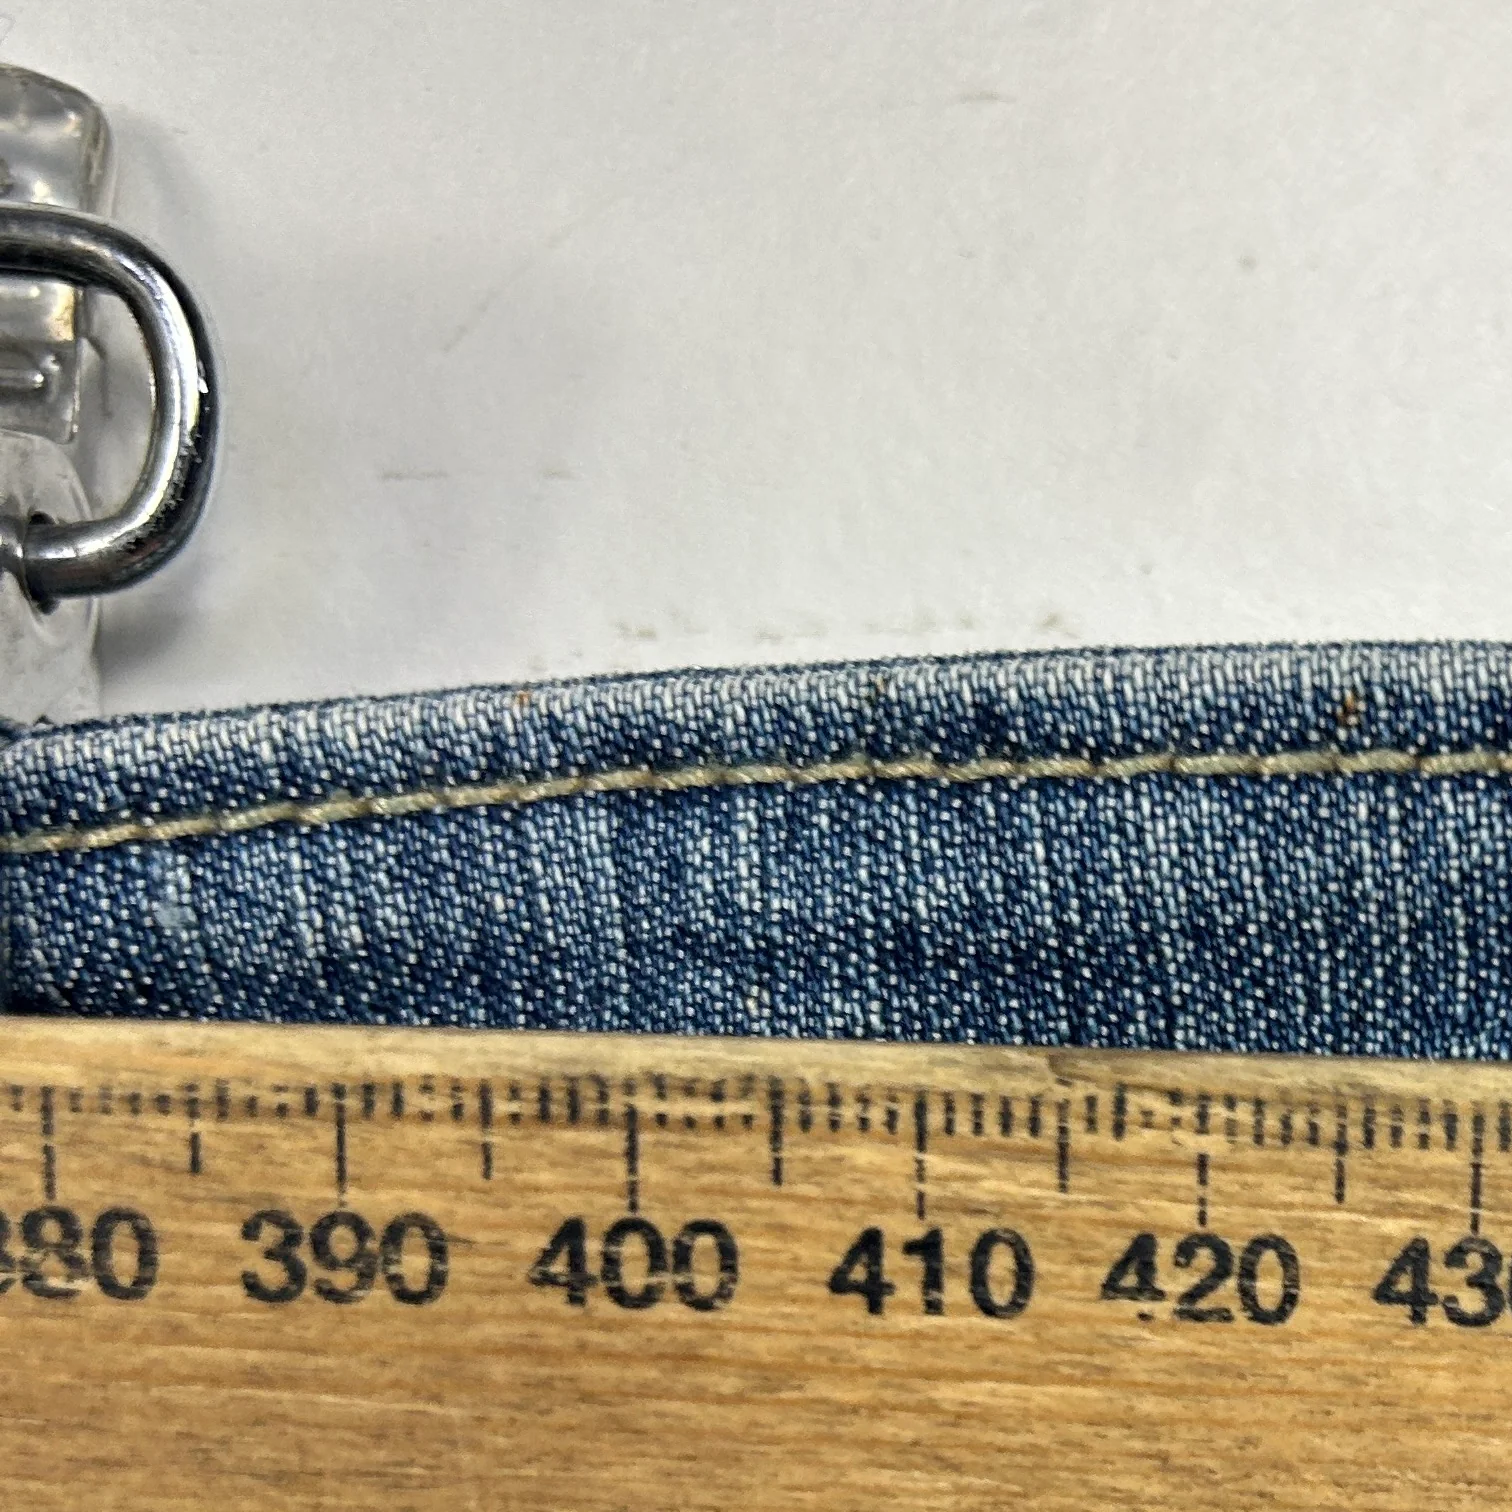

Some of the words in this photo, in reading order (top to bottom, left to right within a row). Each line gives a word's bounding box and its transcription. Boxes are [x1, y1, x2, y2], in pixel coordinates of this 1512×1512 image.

[0, 1206, 158, 1301] 80
[240, 1208, 449, 1306] 390
[528, 1216, 738, 1313] 400
[826, 1226, 1036, 1320] 410
[1099, 1232, 1301, 1326] 420
